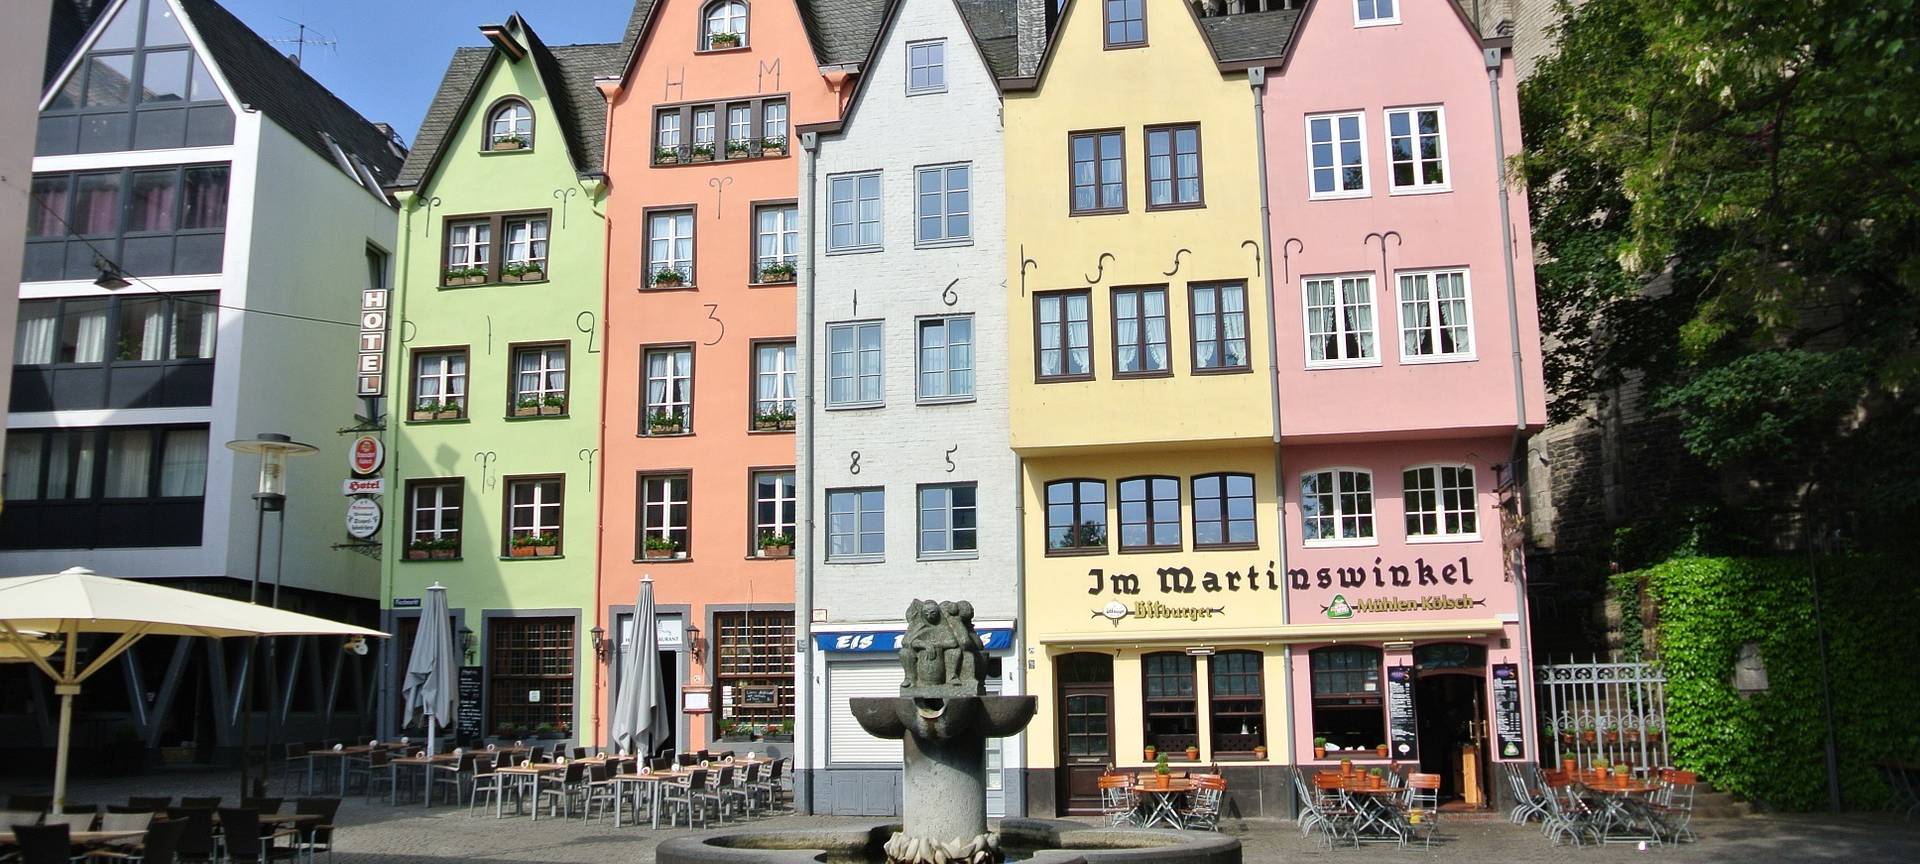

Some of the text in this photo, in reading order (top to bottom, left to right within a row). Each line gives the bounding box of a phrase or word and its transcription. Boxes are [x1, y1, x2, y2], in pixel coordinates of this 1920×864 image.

[665, 57, 780, 101] H M
[942, 278, 960, 307] 6
[703, 303, 725, 346] 3
[361, 291, 384, 394] HOTEL
[850, 443, 958, 475] 8 5
[349, 480, 381, 493] Hotel
[1088, 556, 1474, 596] Im Martinswinkel
[1134, 599, 1214, 622] Bitburger
[1357, 596, 1417, 613] Mühlen
[1421, 593, 1474, 611] Kölsch
[835, 634, 874, 649] EIS
